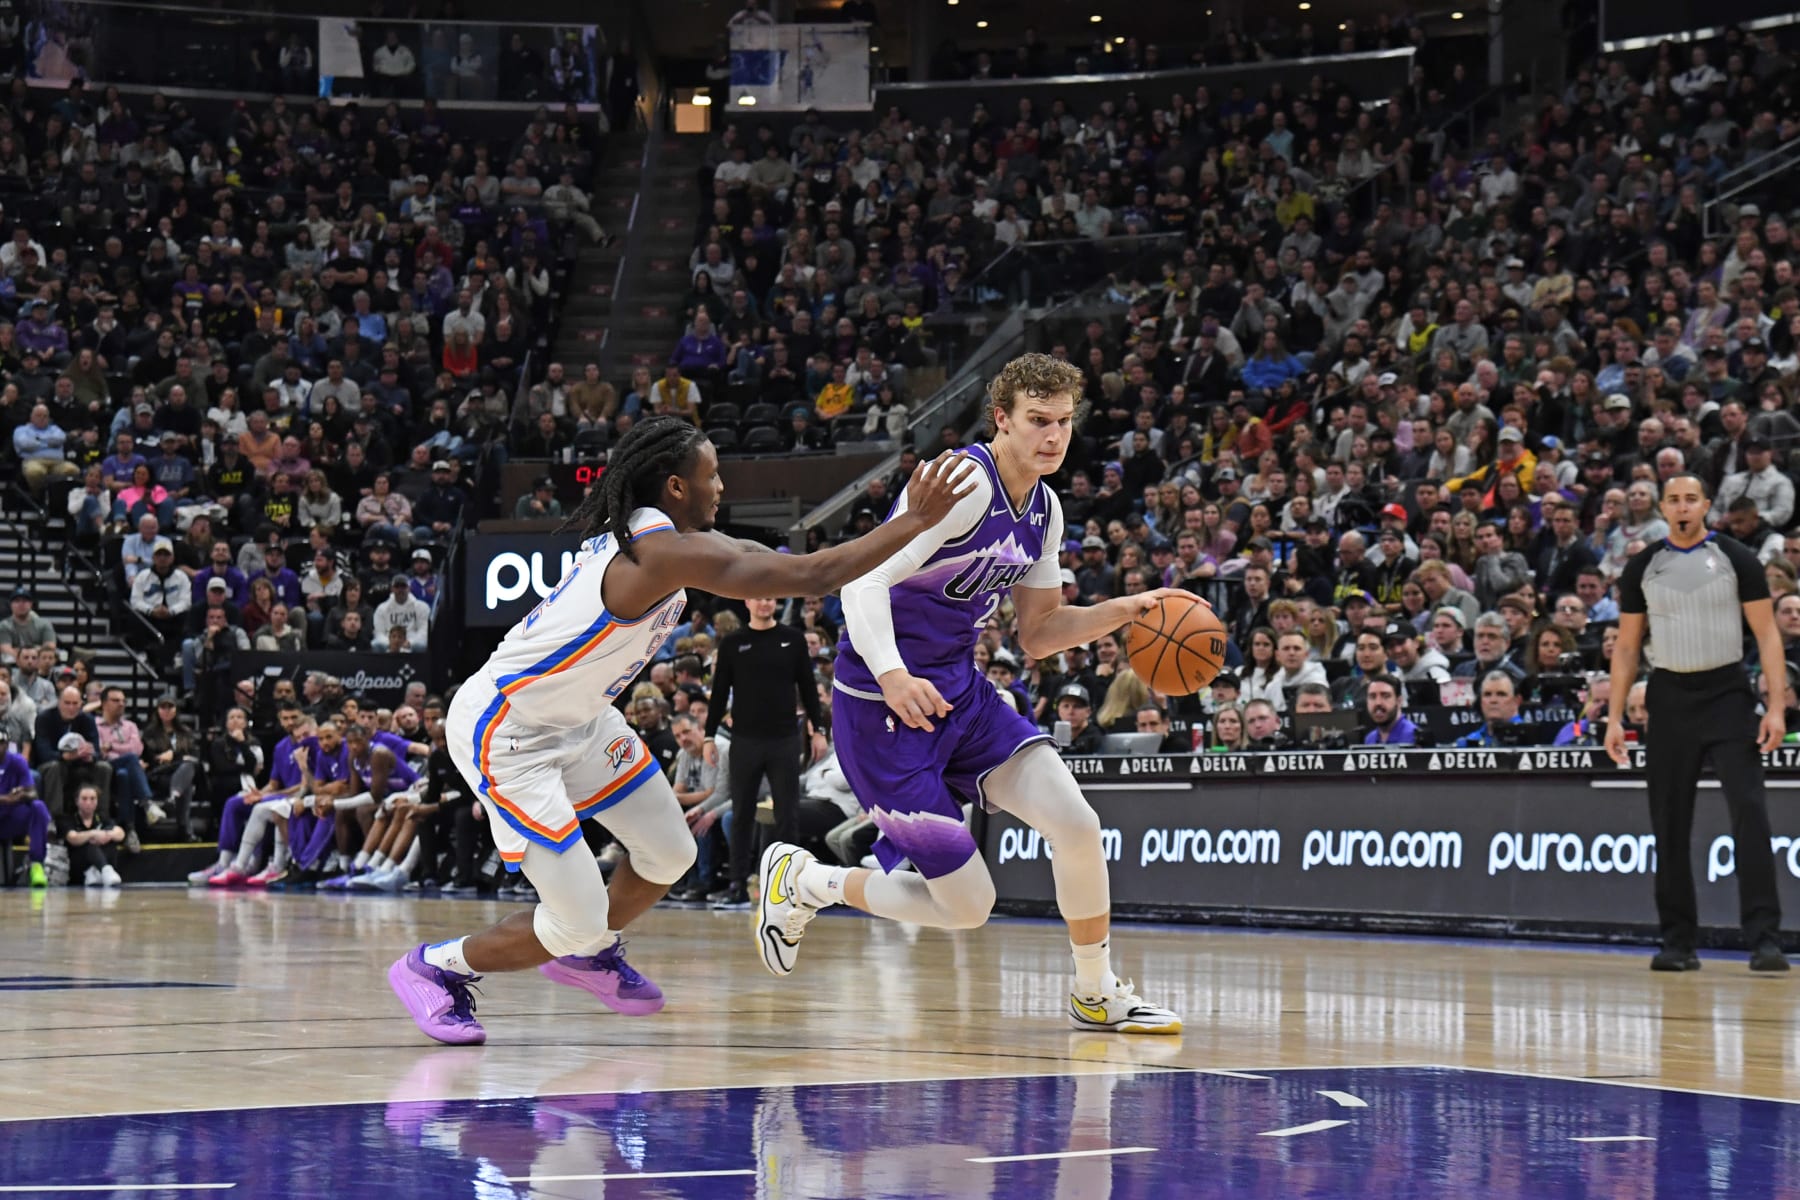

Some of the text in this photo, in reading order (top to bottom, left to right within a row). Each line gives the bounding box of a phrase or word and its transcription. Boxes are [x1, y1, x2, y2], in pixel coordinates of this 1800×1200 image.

[486, 551, 583, 609] pu
[943, 556, 1034, 600] UTAH
[1535, 708, 1575, 721] DELTA
[1132, 758, 1173, 773] DELTA
[1203, 757, 1246, 772] DELTA
[1277, 755, 1324, 770] DELTA
[1358, 753, 1407, 769] DELTA
[1444, 752, 1497, 768] DELTA
[1535, 752, 1592, 768] DELTA
[1140, 828, 1280, 867] pura.com
[1302, 830, 1462, 871] pura.com
